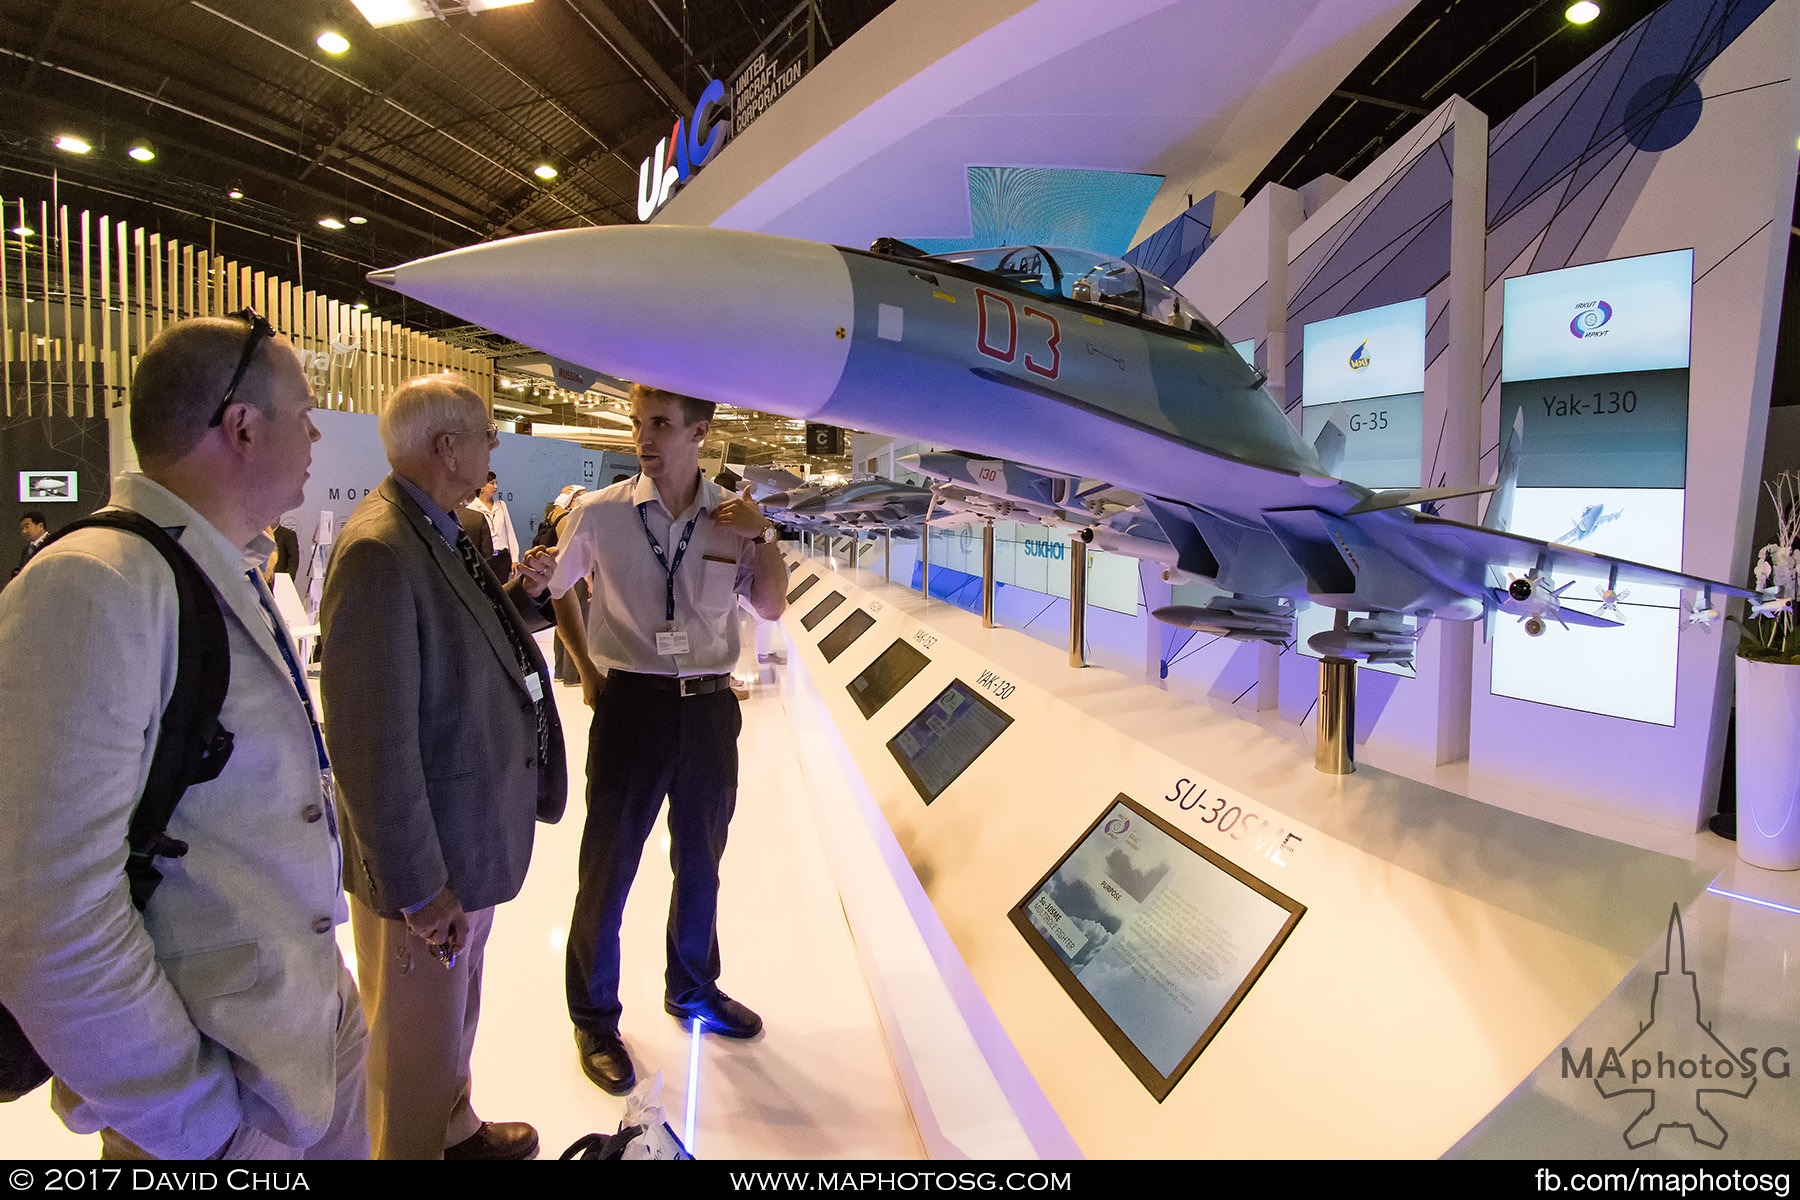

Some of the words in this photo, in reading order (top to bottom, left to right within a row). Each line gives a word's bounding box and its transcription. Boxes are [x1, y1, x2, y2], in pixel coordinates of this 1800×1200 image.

[735, 52, 766, 95] UNITED
[736, 59, 779, 115] AIRCRAFT
[736, 59, 801, 132] CORPORATION
[637, 79, 725, 222] UAC
[1575, 301, 1597, 309] IRKUT
[975, 287, 1061, 381] 03
[1542, 390, 1637, 417] Yak-130
[816, 432, 828, 445] C
[979, 467, 996, 481] 130
[1025, 539, 1065, 561] SUKHOI
[976, 669, 1016, 700] YAK-130
[1100, 880, 1122, 901] PURPOSE
[1033, 902, 1056, 930] MULTIROLE
[1054, 926, 1076, 951] FIGHTER
